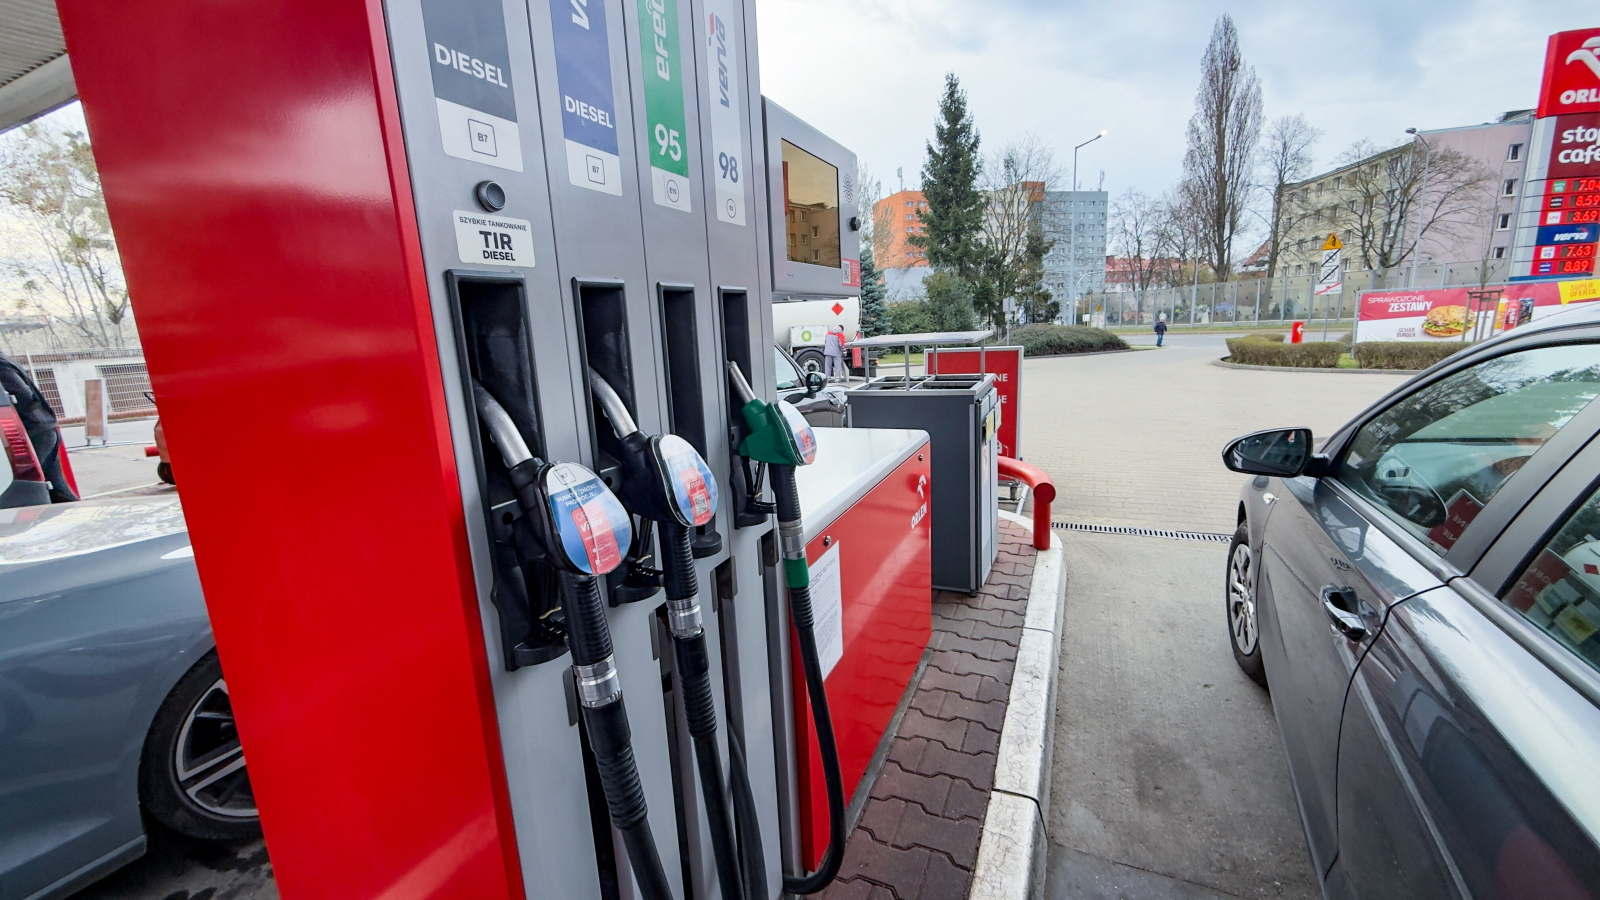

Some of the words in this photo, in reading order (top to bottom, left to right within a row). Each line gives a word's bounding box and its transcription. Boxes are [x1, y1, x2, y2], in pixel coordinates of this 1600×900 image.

[434, 42, 508, 89] DIESEL
[1559, 87, 1600, 105] ORL
[564, 95, 613, 129] DIESEL
[477, 133, 488, 143] B7
[1561, 125, 1600, 146] sto
[654, 123, 682, 162] 95
[592, 165, 600, 174] B7
[718, 151, 739, 184] 98
[1575, 195, 1600, 207] 8.59
[1572, 210, 1598, 221] 3.69
[459, 216, 487, 226] SZYBKIE
[488, 220, 527, 231] TANKOWANIE
[479, 230, 513, 251] TIR
[1553, 232, 1588, 241] verva
[482, 250, 516, 261] DIESEL
[1567, 245, 1591, 257] 7.63
[1564, 260, 1589, 272] 8.89
[1570, 282, 1594, 291] SUPER
[1569, 289, 1596, 297] OFERTA
[1367, 295, 1425, 304] SPRAWDZONE
[1388, 301, 1433, 313] ZESTAWY
[911, 501, 928, 529] ORLEN
